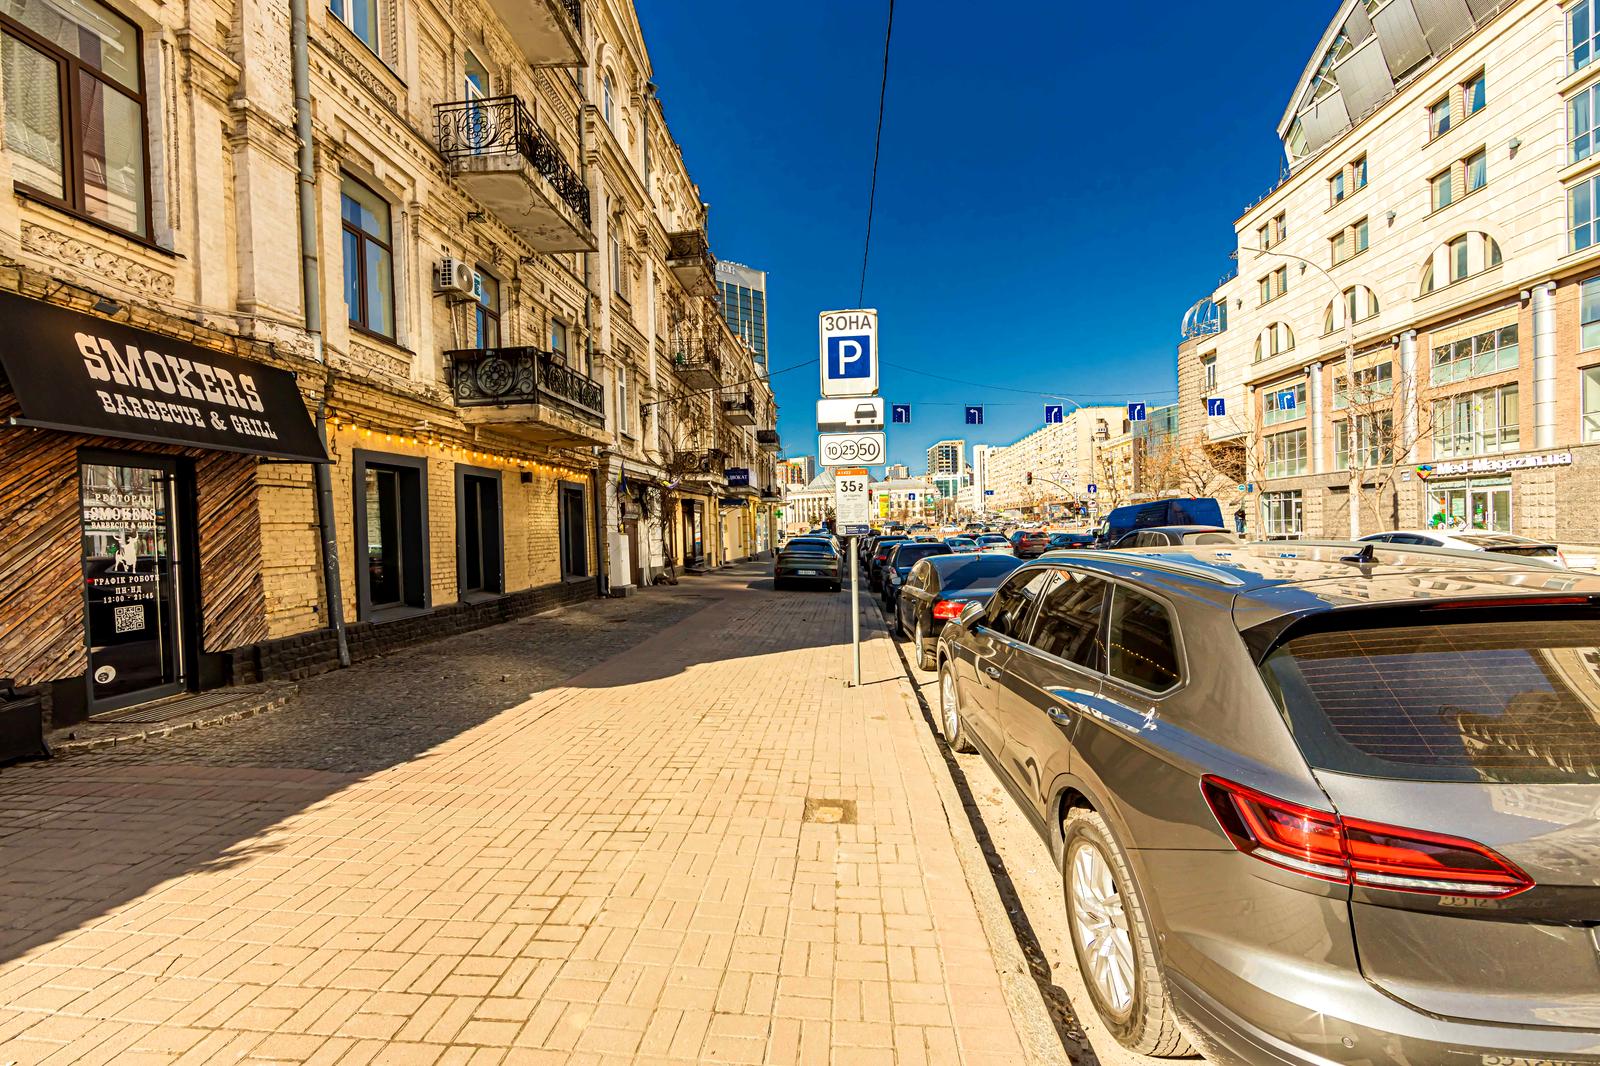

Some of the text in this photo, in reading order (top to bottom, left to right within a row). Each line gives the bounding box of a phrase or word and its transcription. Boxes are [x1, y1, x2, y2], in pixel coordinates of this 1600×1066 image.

[825, 315, 872, 331] ЗОНА
[838, 339, 862, 375] P
[74, 332, 264, 412] SMOKERS
[96, 390, 278, 440] BARBECUE & GRILL
[828, 442, 876, 456] 10 25 50
[95, 494, 151, 505] РЕСТОРАН
[90, 507, 156, 521] SMOKERS
[94, 576, 126, 586] ГРАФІК
[103, 595, 125, 604] 12:00
